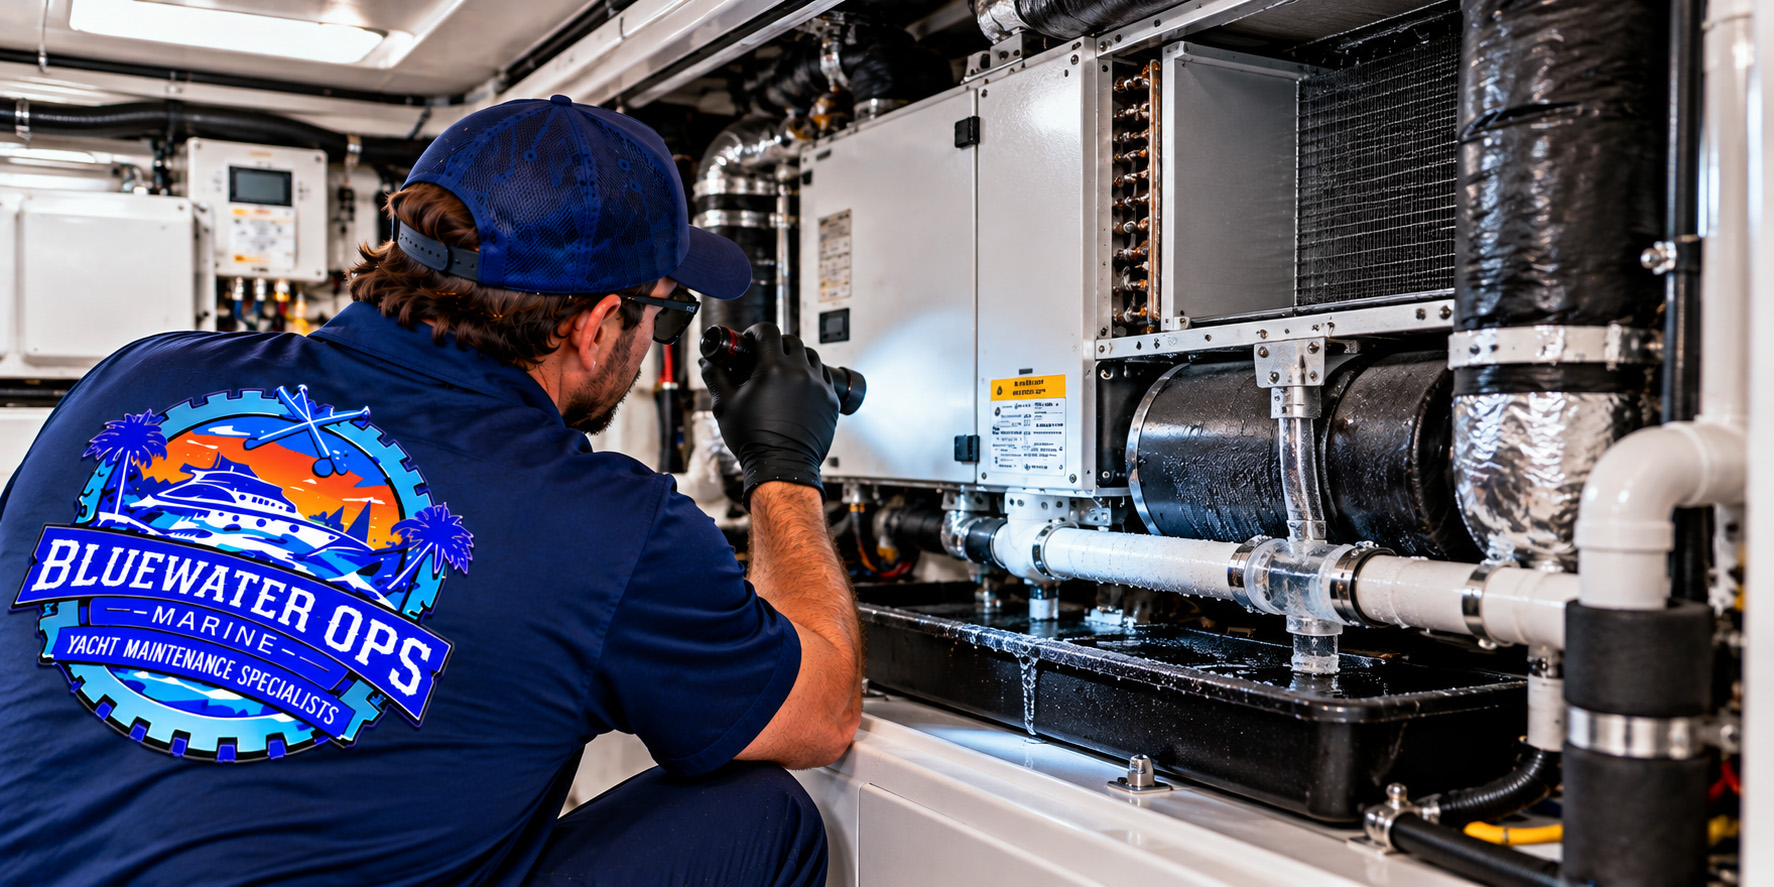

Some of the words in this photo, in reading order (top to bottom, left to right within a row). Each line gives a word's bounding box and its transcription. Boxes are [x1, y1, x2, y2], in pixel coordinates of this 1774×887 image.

[31, 539, 316, 633] BLUEWATER
[323, 604, 431, 697] OPS
[151, 605, 278, 656] MARINE
[66, 635, 122, 657] YACHT
[123, 638, 236, 681] MAINTENANCE
[236, 665, 340, 725] SPECIALISTS
